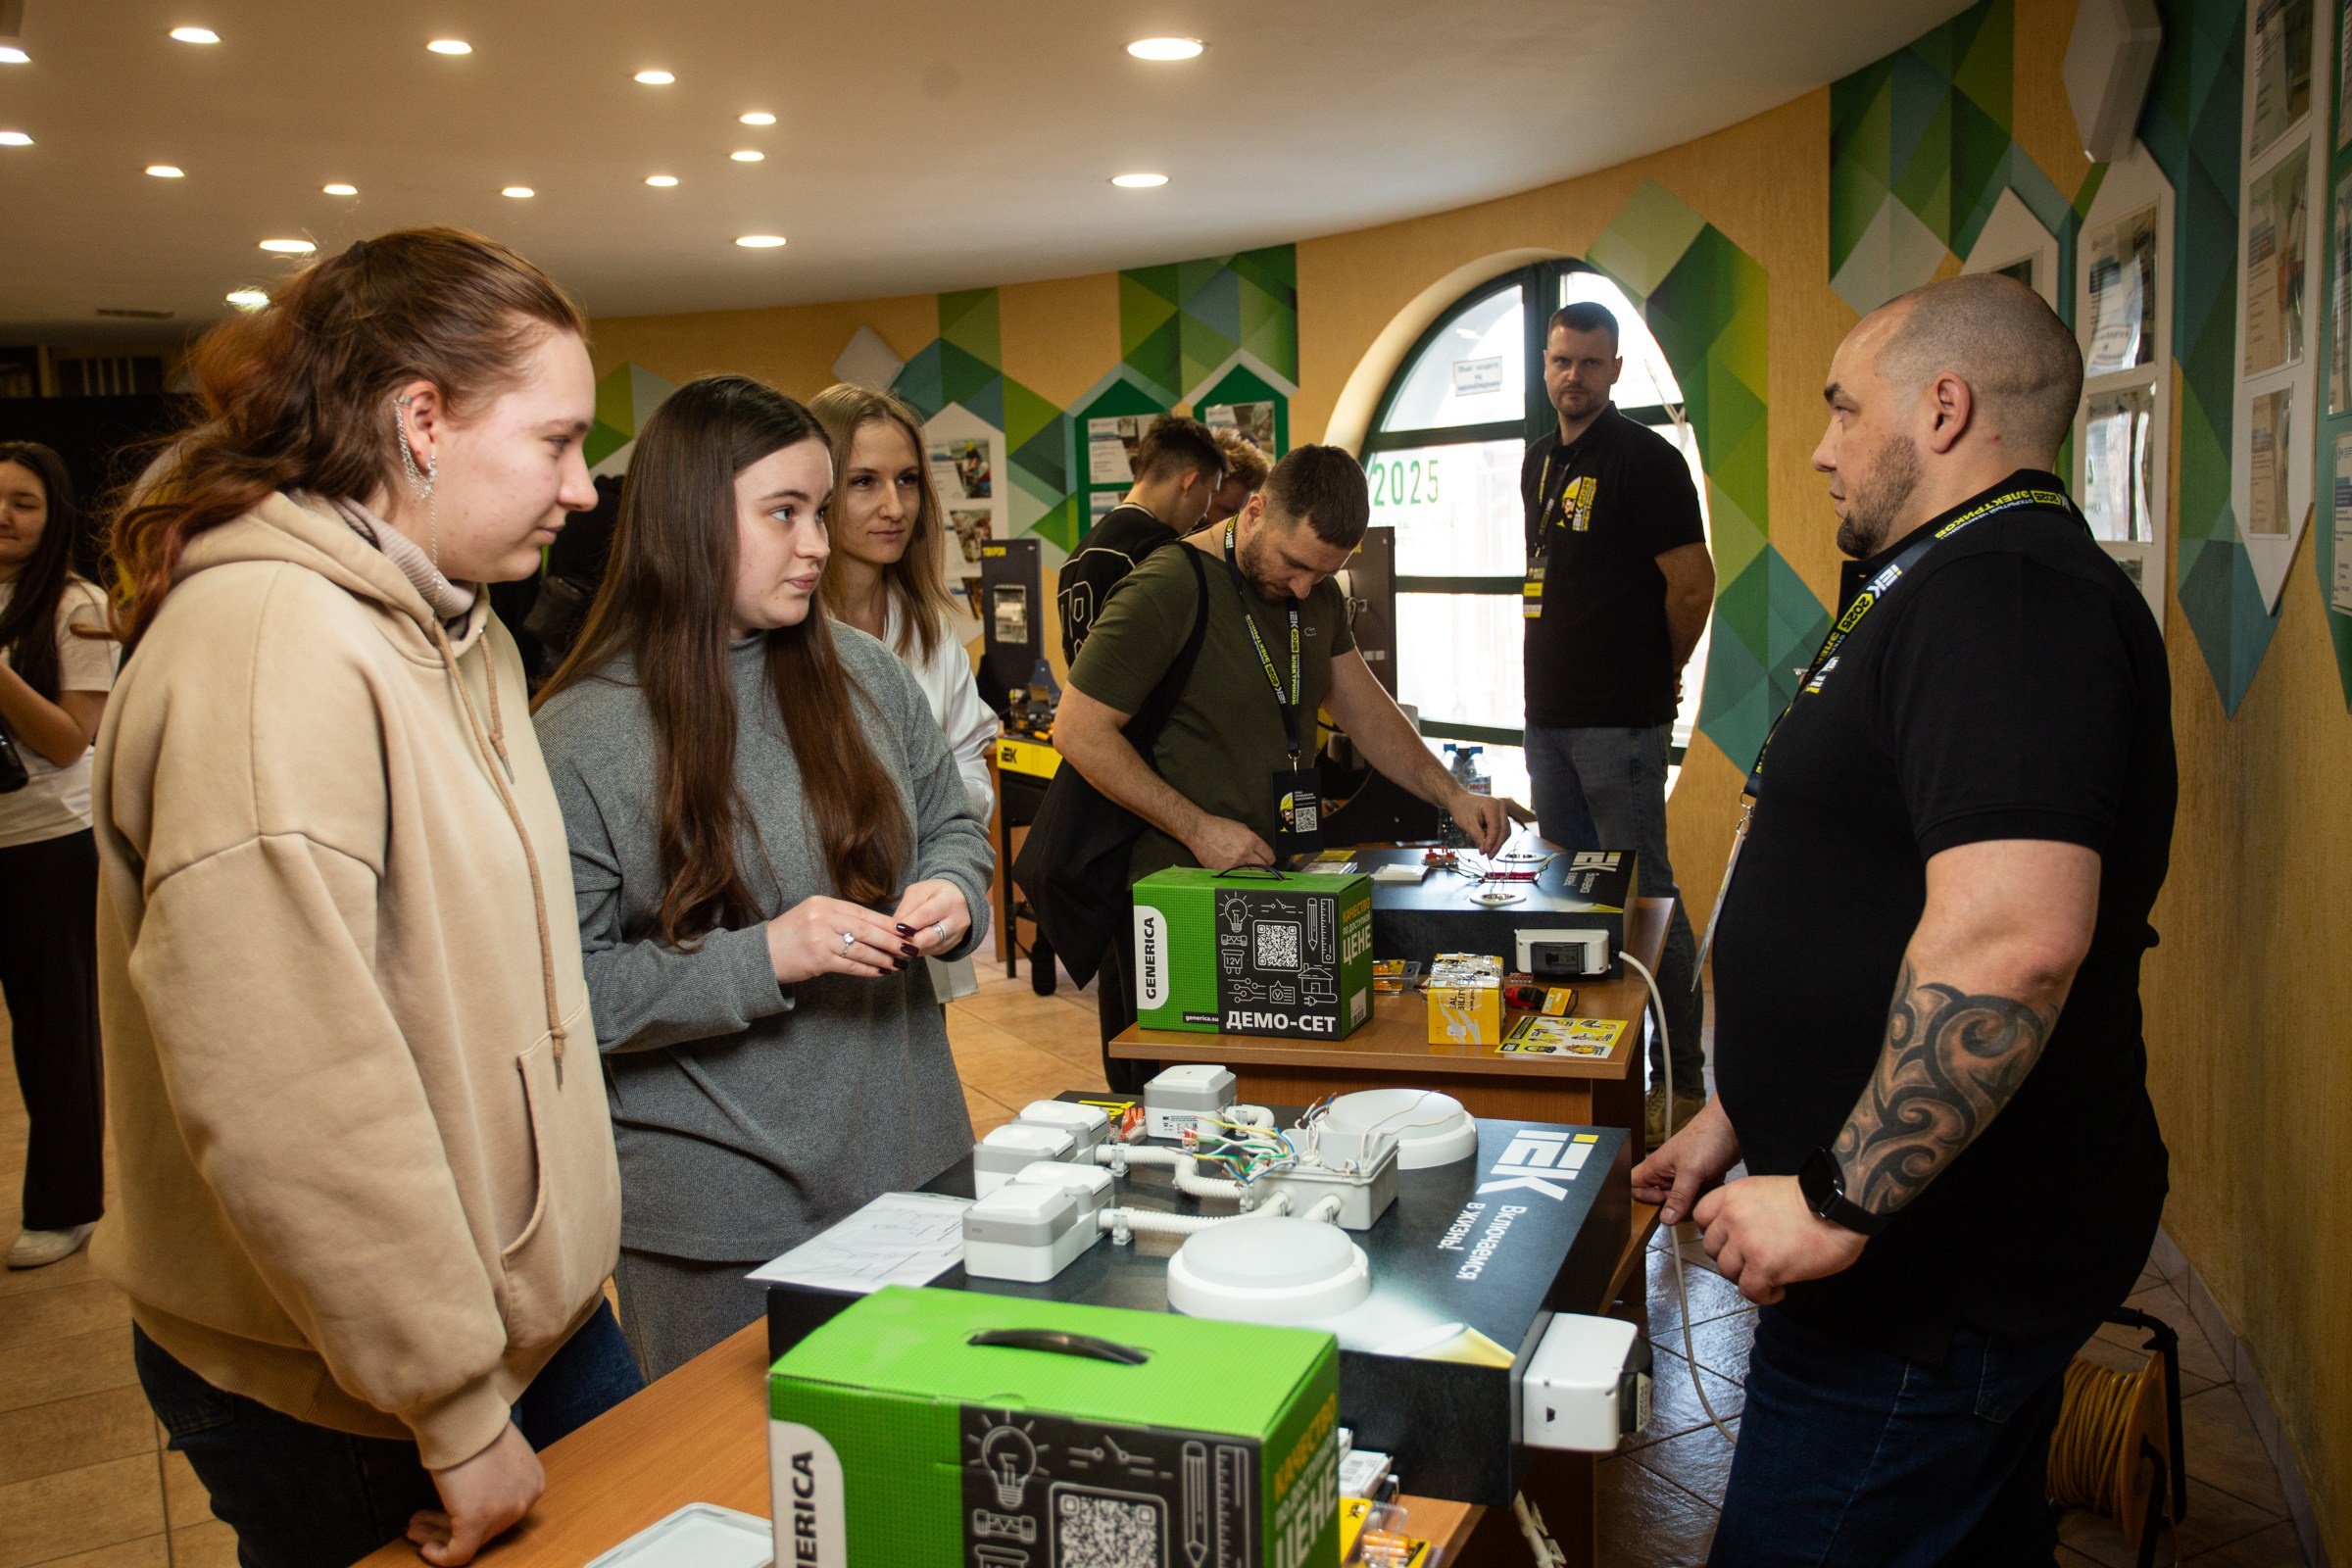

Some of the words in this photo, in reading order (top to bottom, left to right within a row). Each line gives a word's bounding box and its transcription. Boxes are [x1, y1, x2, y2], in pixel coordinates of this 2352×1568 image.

[1372, 460, 1439, 507] 2025
[1935, 490, 2031, 539] ЭЛЕКТРИКОВ
[1841, 596, 1870, 630] 2025
[1342, 896, 1371, 924] КАЧЕСТВО
[1146, 915, 1156, 1000] GENERICA
[1225, 956, 1241, 966] 12V
[1343, 923, 1371, 966] ЦЕНЕ
[1185, 1014, 1219, 1023] generica.su
[1226, 1010, 1336, 1033] ДЕМО-СЕТ
[1437, 1209, 1481, 1251] жизнь!
[1455, 1204, 1528, 1281] Включаемся
